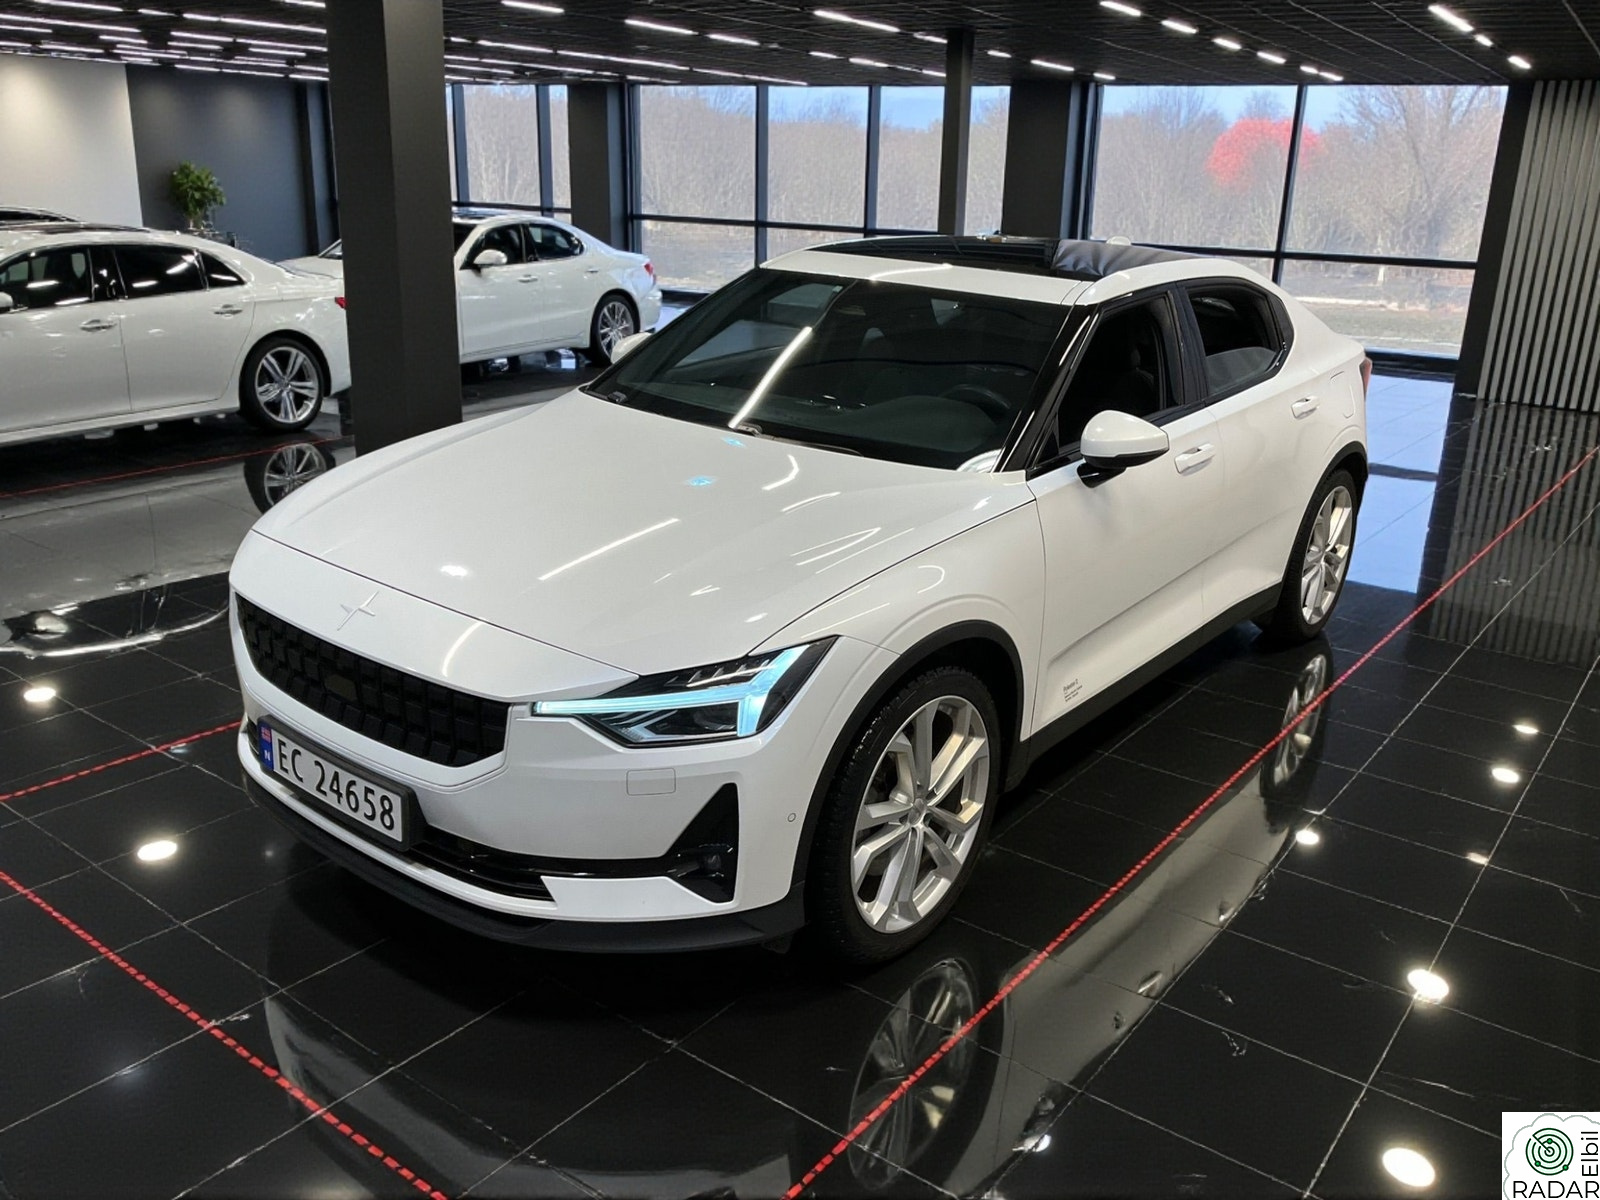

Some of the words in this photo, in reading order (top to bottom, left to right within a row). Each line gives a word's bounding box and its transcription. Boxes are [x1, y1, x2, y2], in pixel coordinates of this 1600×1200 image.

[264, 750, 271, 761] N
[277, 739, 304, 783] EC
[314, 760, 395, 831] 24658
